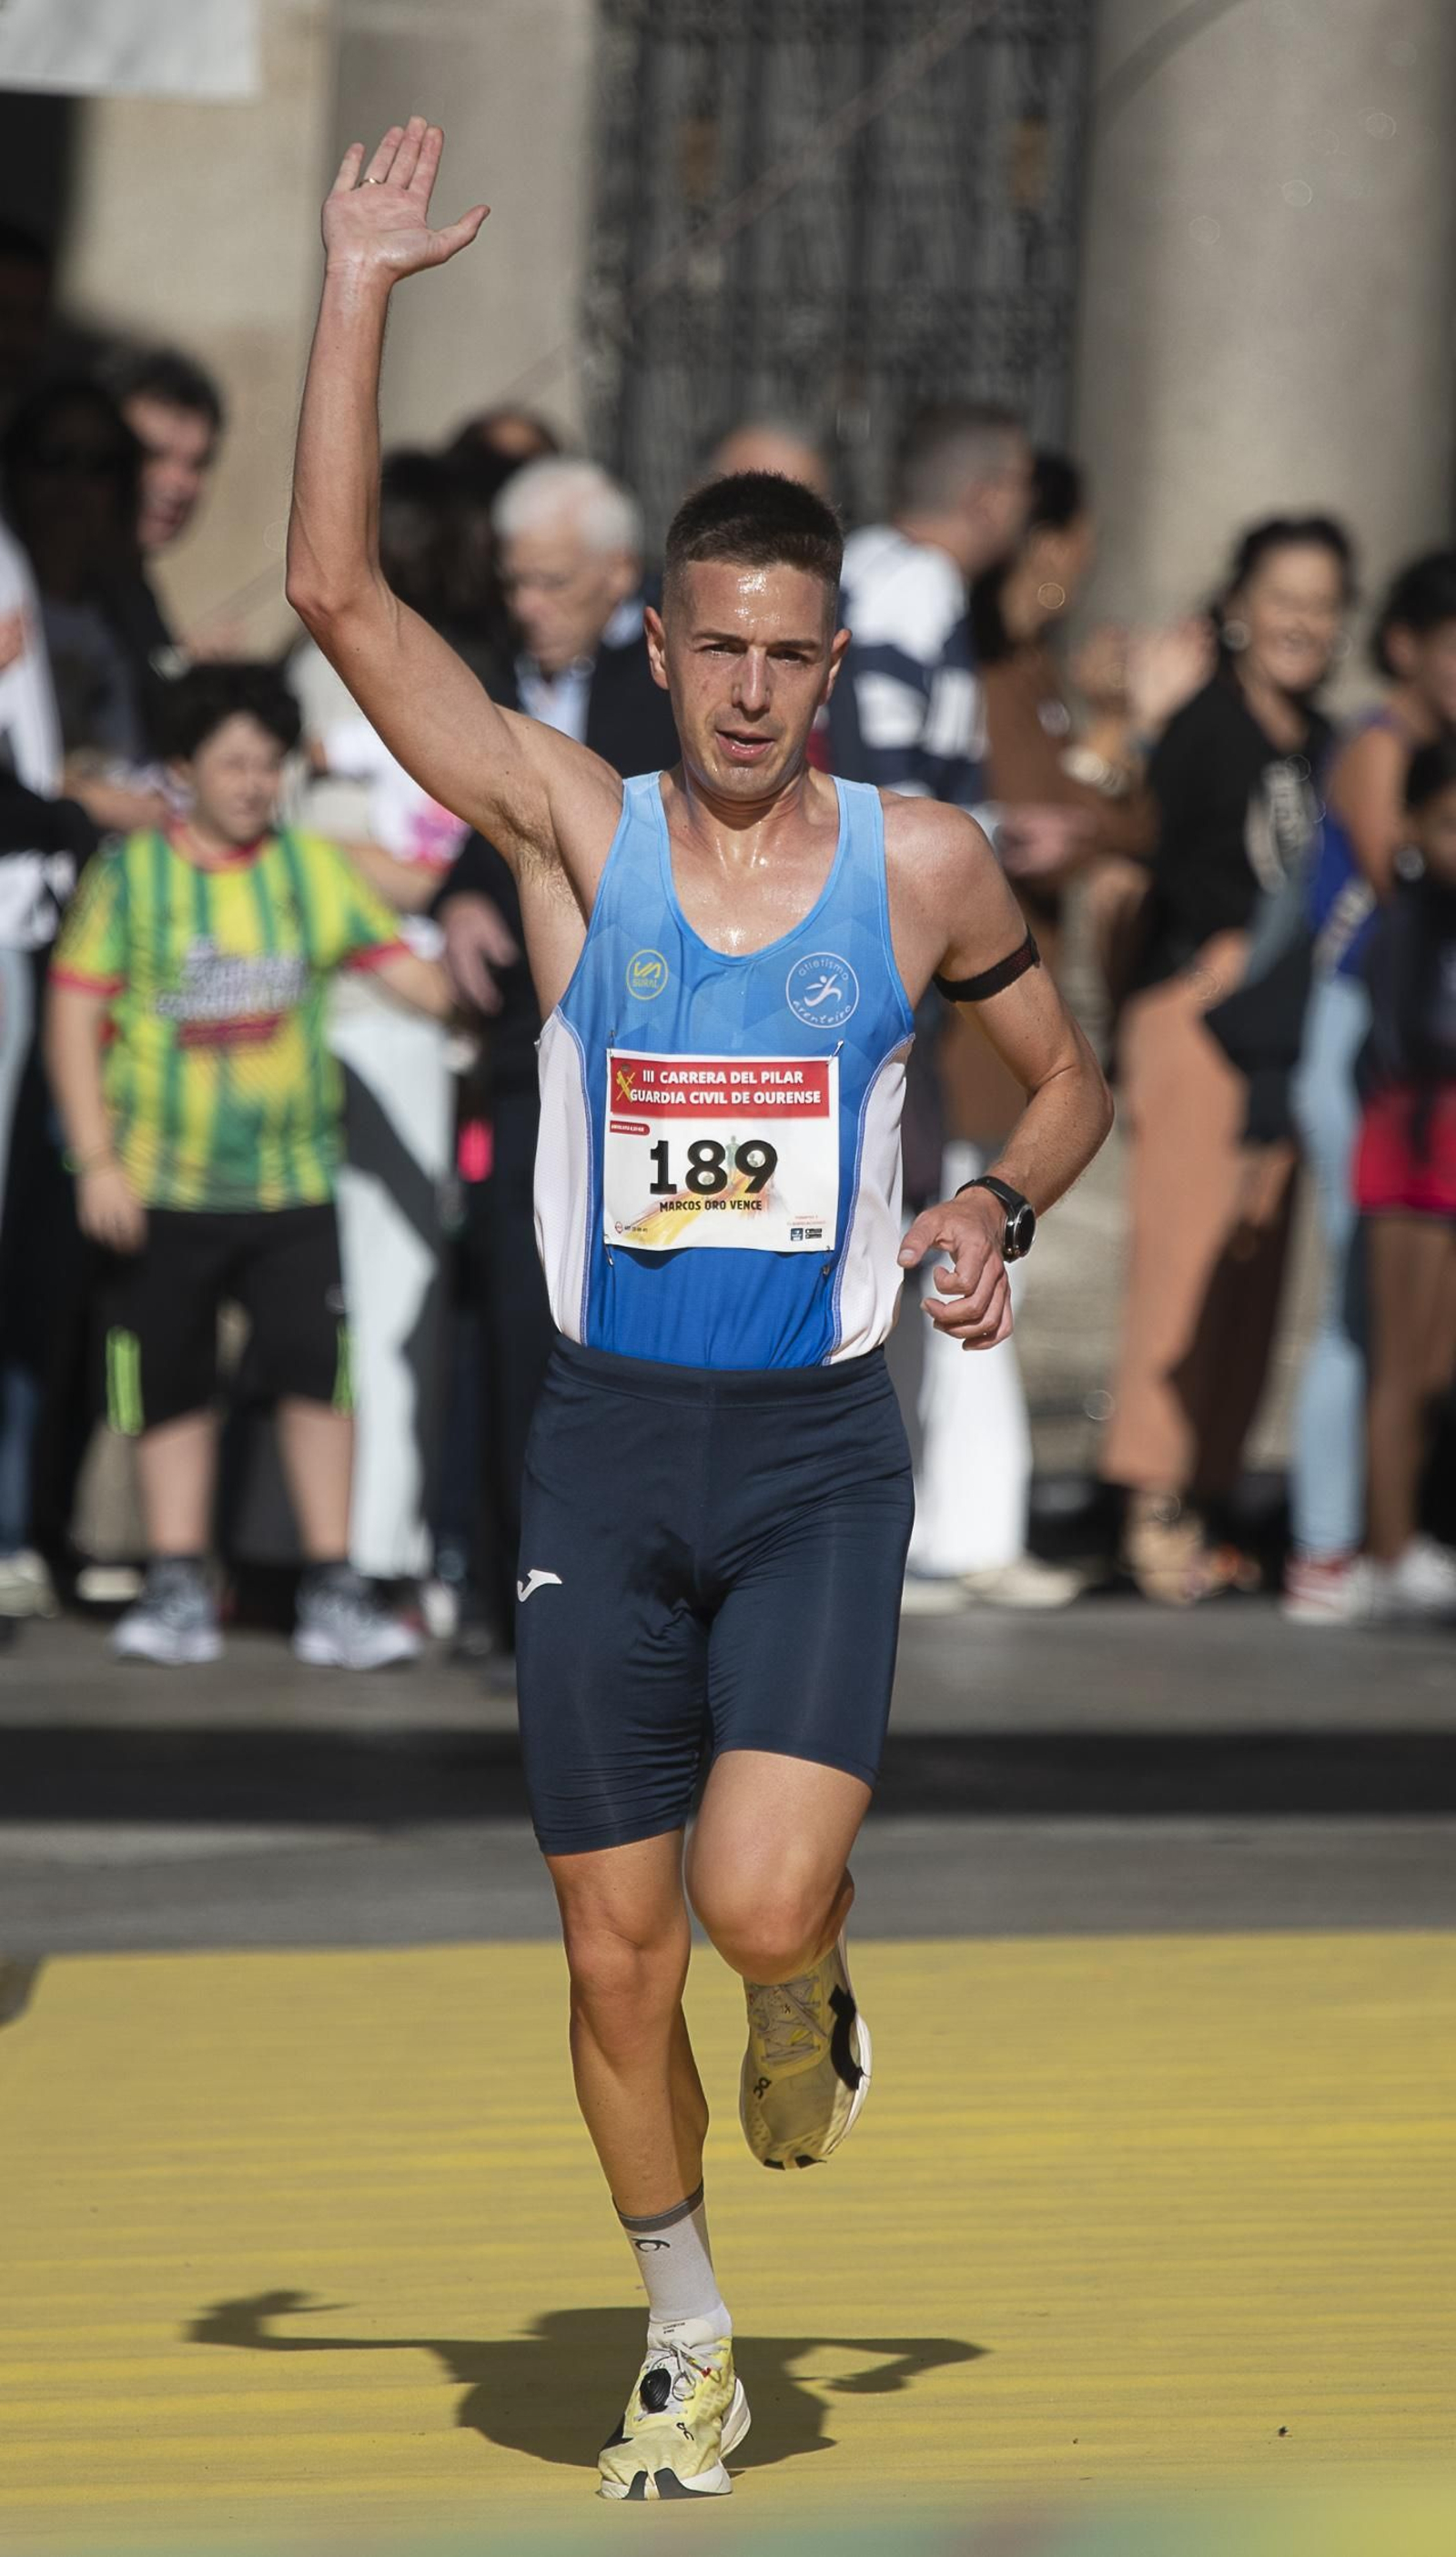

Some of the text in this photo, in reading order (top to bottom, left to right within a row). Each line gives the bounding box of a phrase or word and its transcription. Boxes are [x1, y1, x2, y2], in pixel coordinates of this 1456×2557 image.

[643, 1070, 804, 1084] III CARRERA DEL PILAR
[630, 1089, 821, 1104] GUARDIA CIVIL DE OURENSE
[650, 1140, 778, 1194] 189
[659, 1200, 763, 1213] MARCOS ORO VENCE
